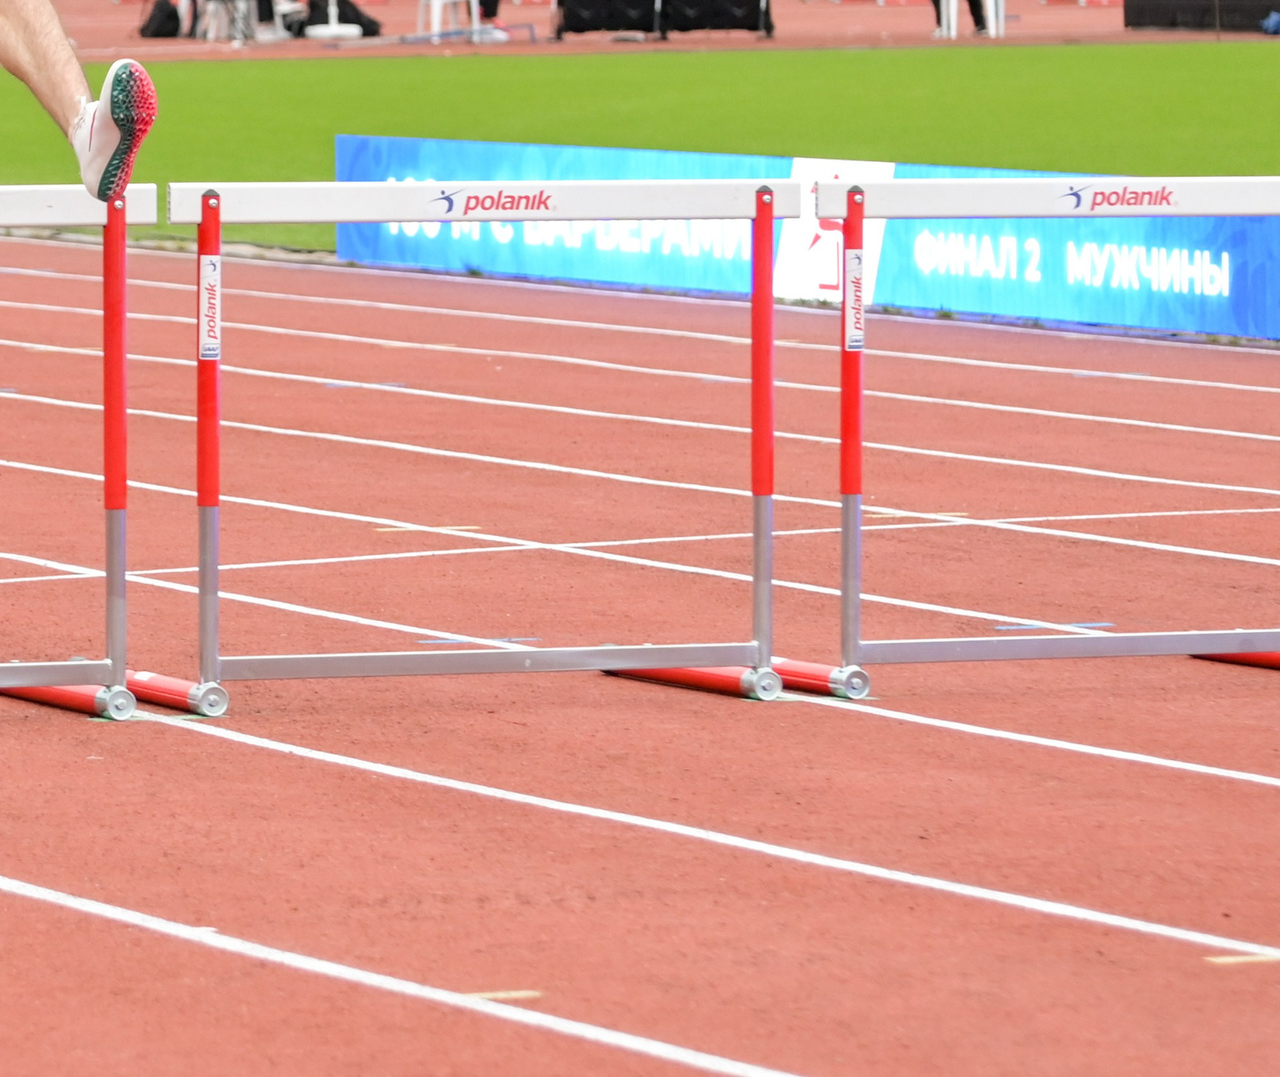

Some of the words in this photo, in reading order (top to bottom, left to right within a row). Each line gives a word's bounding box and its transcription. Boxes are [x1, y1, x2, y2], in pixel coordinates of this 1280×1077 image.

[462, 189, 552, 216] polanik
[1090, 185, 1174, 212] polanik
[914, 229, 1018, 280] ФИНАЛ
[1024, 237, 1042, 283] 2
[1067, 240, 1230, 297] МУЖЧИНЫ
[204, 282, 218, 340] polanik
[850, 275, 864, 331] polanik
